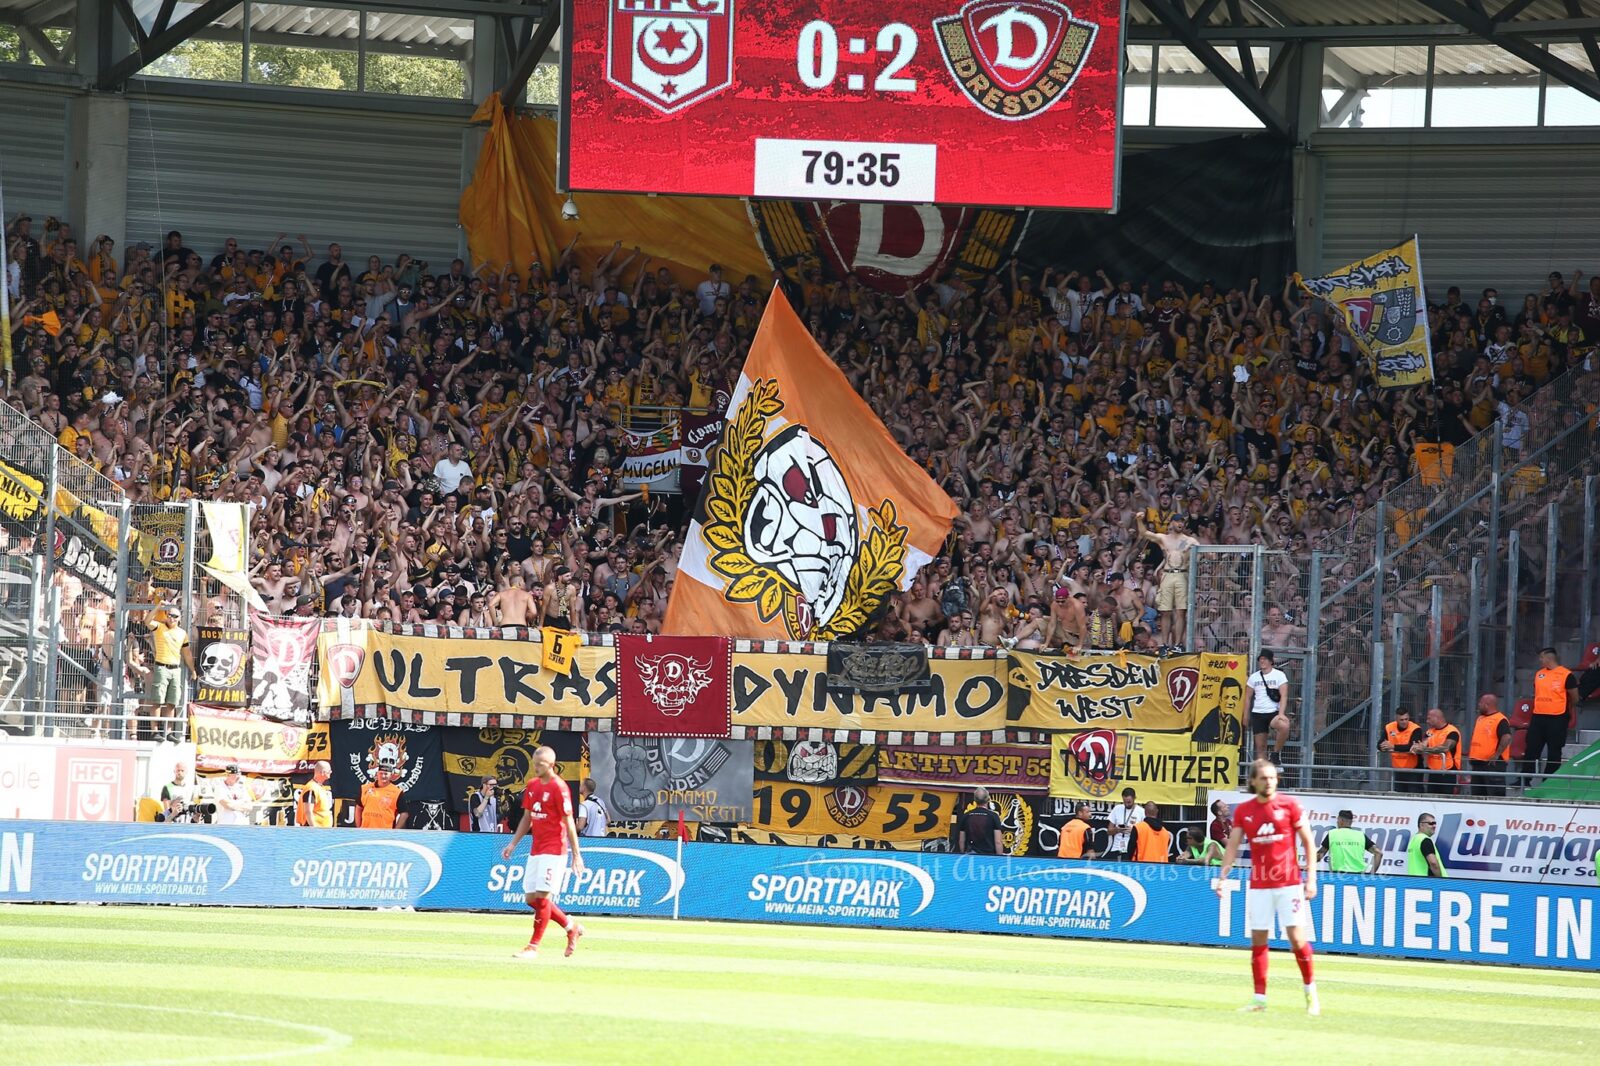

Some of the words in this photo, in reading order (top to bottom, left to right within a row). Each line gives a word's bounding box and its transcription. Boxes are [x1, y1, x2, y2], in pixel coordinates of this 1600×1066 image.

[797, 19, 918, 92] 0:2
[954, 57, 1075, 116] DRESDEN
[801, 150, 901, 188] 79:35
[1035, 661, 1159, 691] DRESDEN
[198, 687, 246, 702] DYNAMO
[1056, 695, 1145, 723] WEST
[196, 726, 274, 751] BRIGADE
[75, 765, 114, 780] HFC
[879, 750, 1022, 776] AKTIVIST
[656, 789, 718, 806] DYNAMO
[829, 807, 868, 828] DRESDEN
[882, 792, 942, 834] 53
[1505, 818, 1600, 834] Wohn-Cen
[81, 852, 213, 883] SPORTPARK
[290, 858, 414, 889] SPORTPARK
[487, 864, 646, 896] SPTPARK
[1509, 865, 1533, 874] an
[1538, 863, 1570, 875] der
[94, 883, 208, 896] WWW.MEIN-SPORTPARK.DE
[302, 888, 409, 901] WWW.MEIN-SPORTPARK.DE
[748, 873, 904, 908] SPORTPARK
[985, 884, 1116, 918] SPORTPARK
[764, 902, 901, 919] WWW.MEIN-SPORTPARK.DE
[998, 914, 1111, 931] WWW.MEIN-SPORTPARK.DE
[1210, 877, 1510, 955] TINIERE
[1534, 895, 1593, 960] IN
